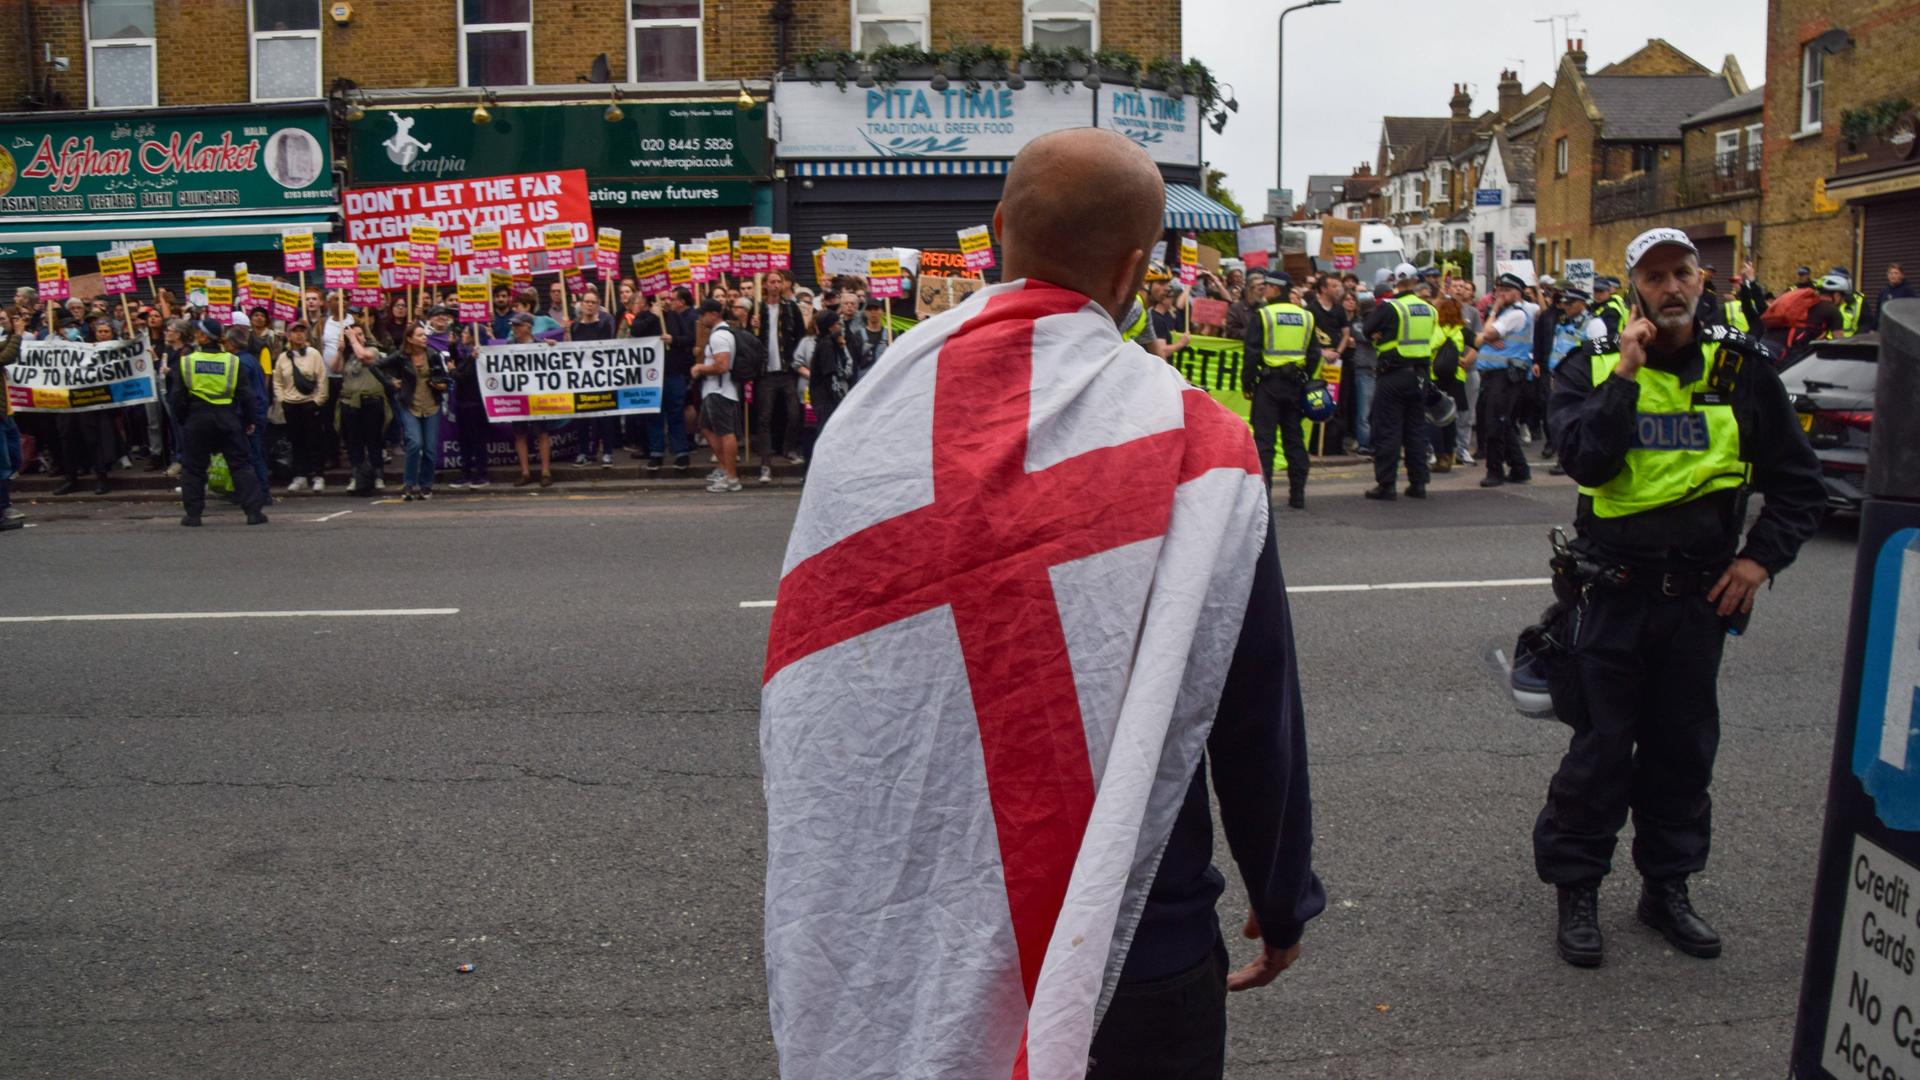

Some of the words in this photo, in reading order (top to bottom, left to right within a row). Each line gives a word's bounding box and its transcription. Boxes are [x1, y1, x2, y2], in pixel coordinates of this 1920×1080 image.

[867, 89, 931, 118] PITA
[940, 88, 1014, 118] TIME
[1113, 91, 1146, 117] PITA
[1149, 95, 1185, 121] TIME
[866, 122, 940, 134] TRADITIONAL
[944, 122, 980, 134] GREEK
[984, 122, 1014, 134] FOOD
[641, 138, 665, 151] 020
[668, 138, 700, 150] 8445
[703, 138, 733, 150] 5826
[21, 133, 131, 192] Afghan
[139, 130, 261, 174] Market
[631, 154, 733, 170] www.terapia.co.uk
[1, 196, 38, 212] ASIAN
[345, 189, 412, 215] DON'T
[419, 183, 464, 208] LET
[470, 179, 516, 205] THE
[520, 174, 562, 198] FAR
[589, 187, 627, 204] ating
[631, 188, 663, 201] new
[666, 185, 719, 199] futures
[433, 203, 524, 231] DIVIDE
[528, 200, 560, 222] US
[504, 223, 589, 251] HATD
[13, 367, 38, 385] UP
[43, 370, 61, 386] TO
[65, 359, 134, 386] RACISM
[486, 351, 585, 374] HARINGEY
[591, 346, 656, 369] STAND
[502, 373, 529, 392] UP
[535, 372, 561, 391] TO
[567, 366, 643, 389] RACISM
[1638, 416, 1706, 447] OLICE
[1855, 855, 1910, 918] Credit
[1862, 911, 1916, 976] Cards
[1849, 970, 1882, 1026] No
